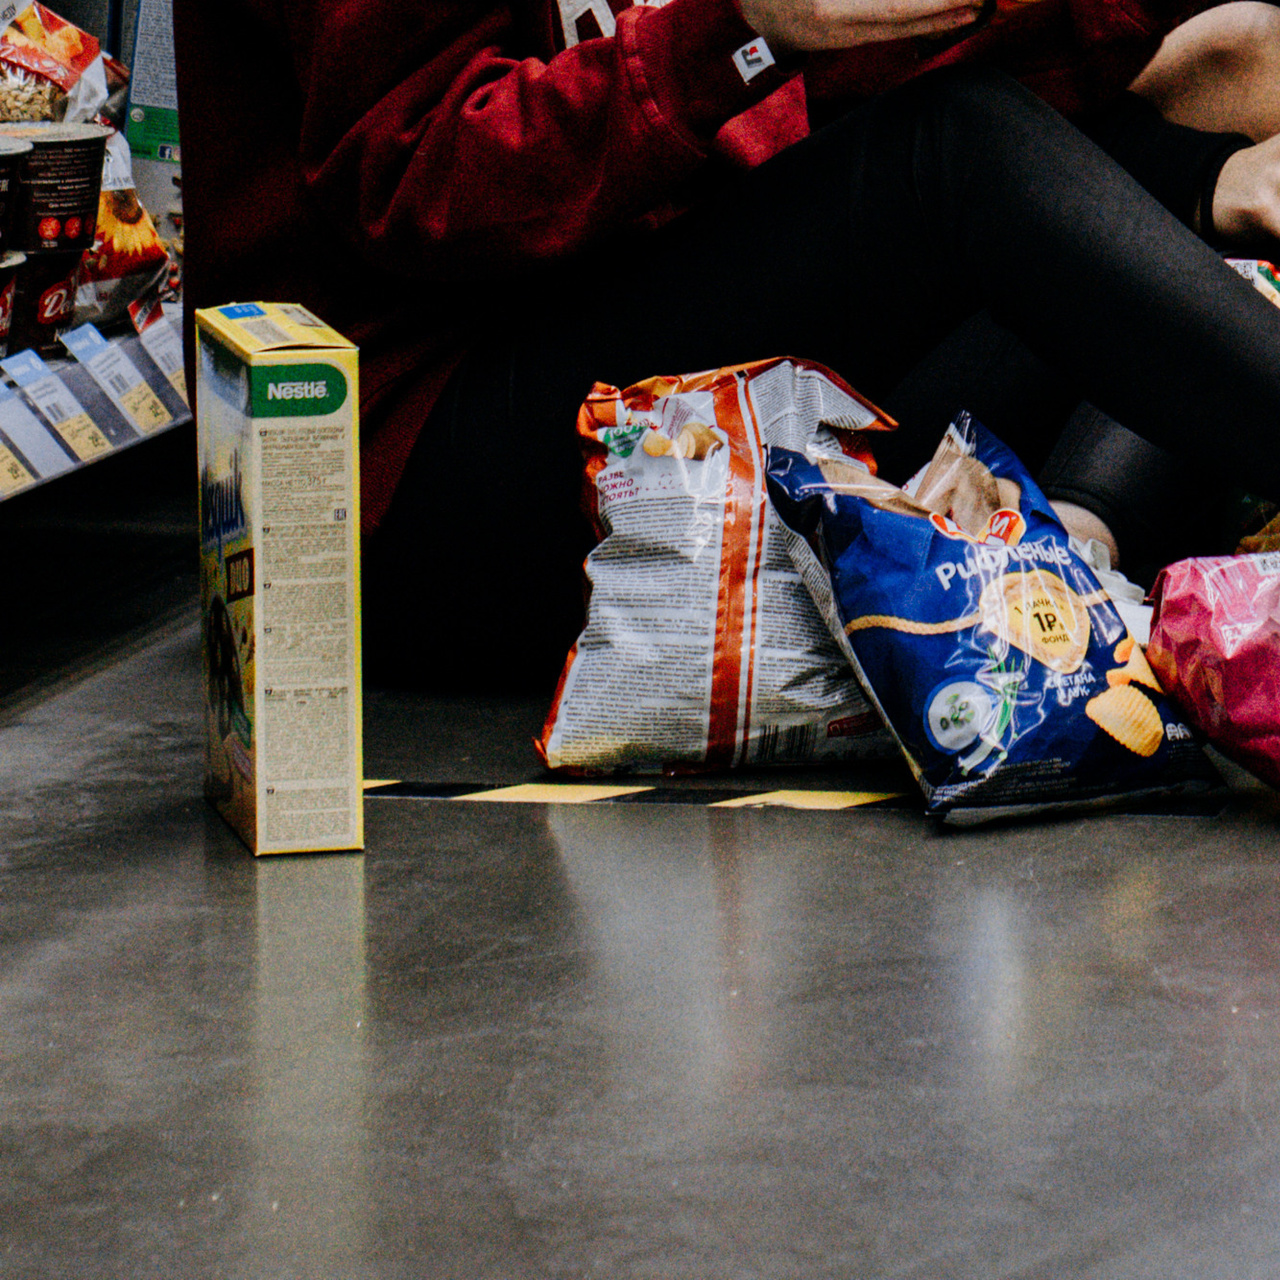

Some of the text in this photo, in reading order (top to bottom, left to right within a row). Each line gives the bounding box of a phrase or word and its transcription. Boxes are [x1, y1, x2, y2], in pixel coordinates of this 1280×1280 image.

[598, 470, 625, 484] РАЗВЕ
[935, 541, 1072, 591] Рифленые
[1041, 633, 1070, 644] ФОНД
